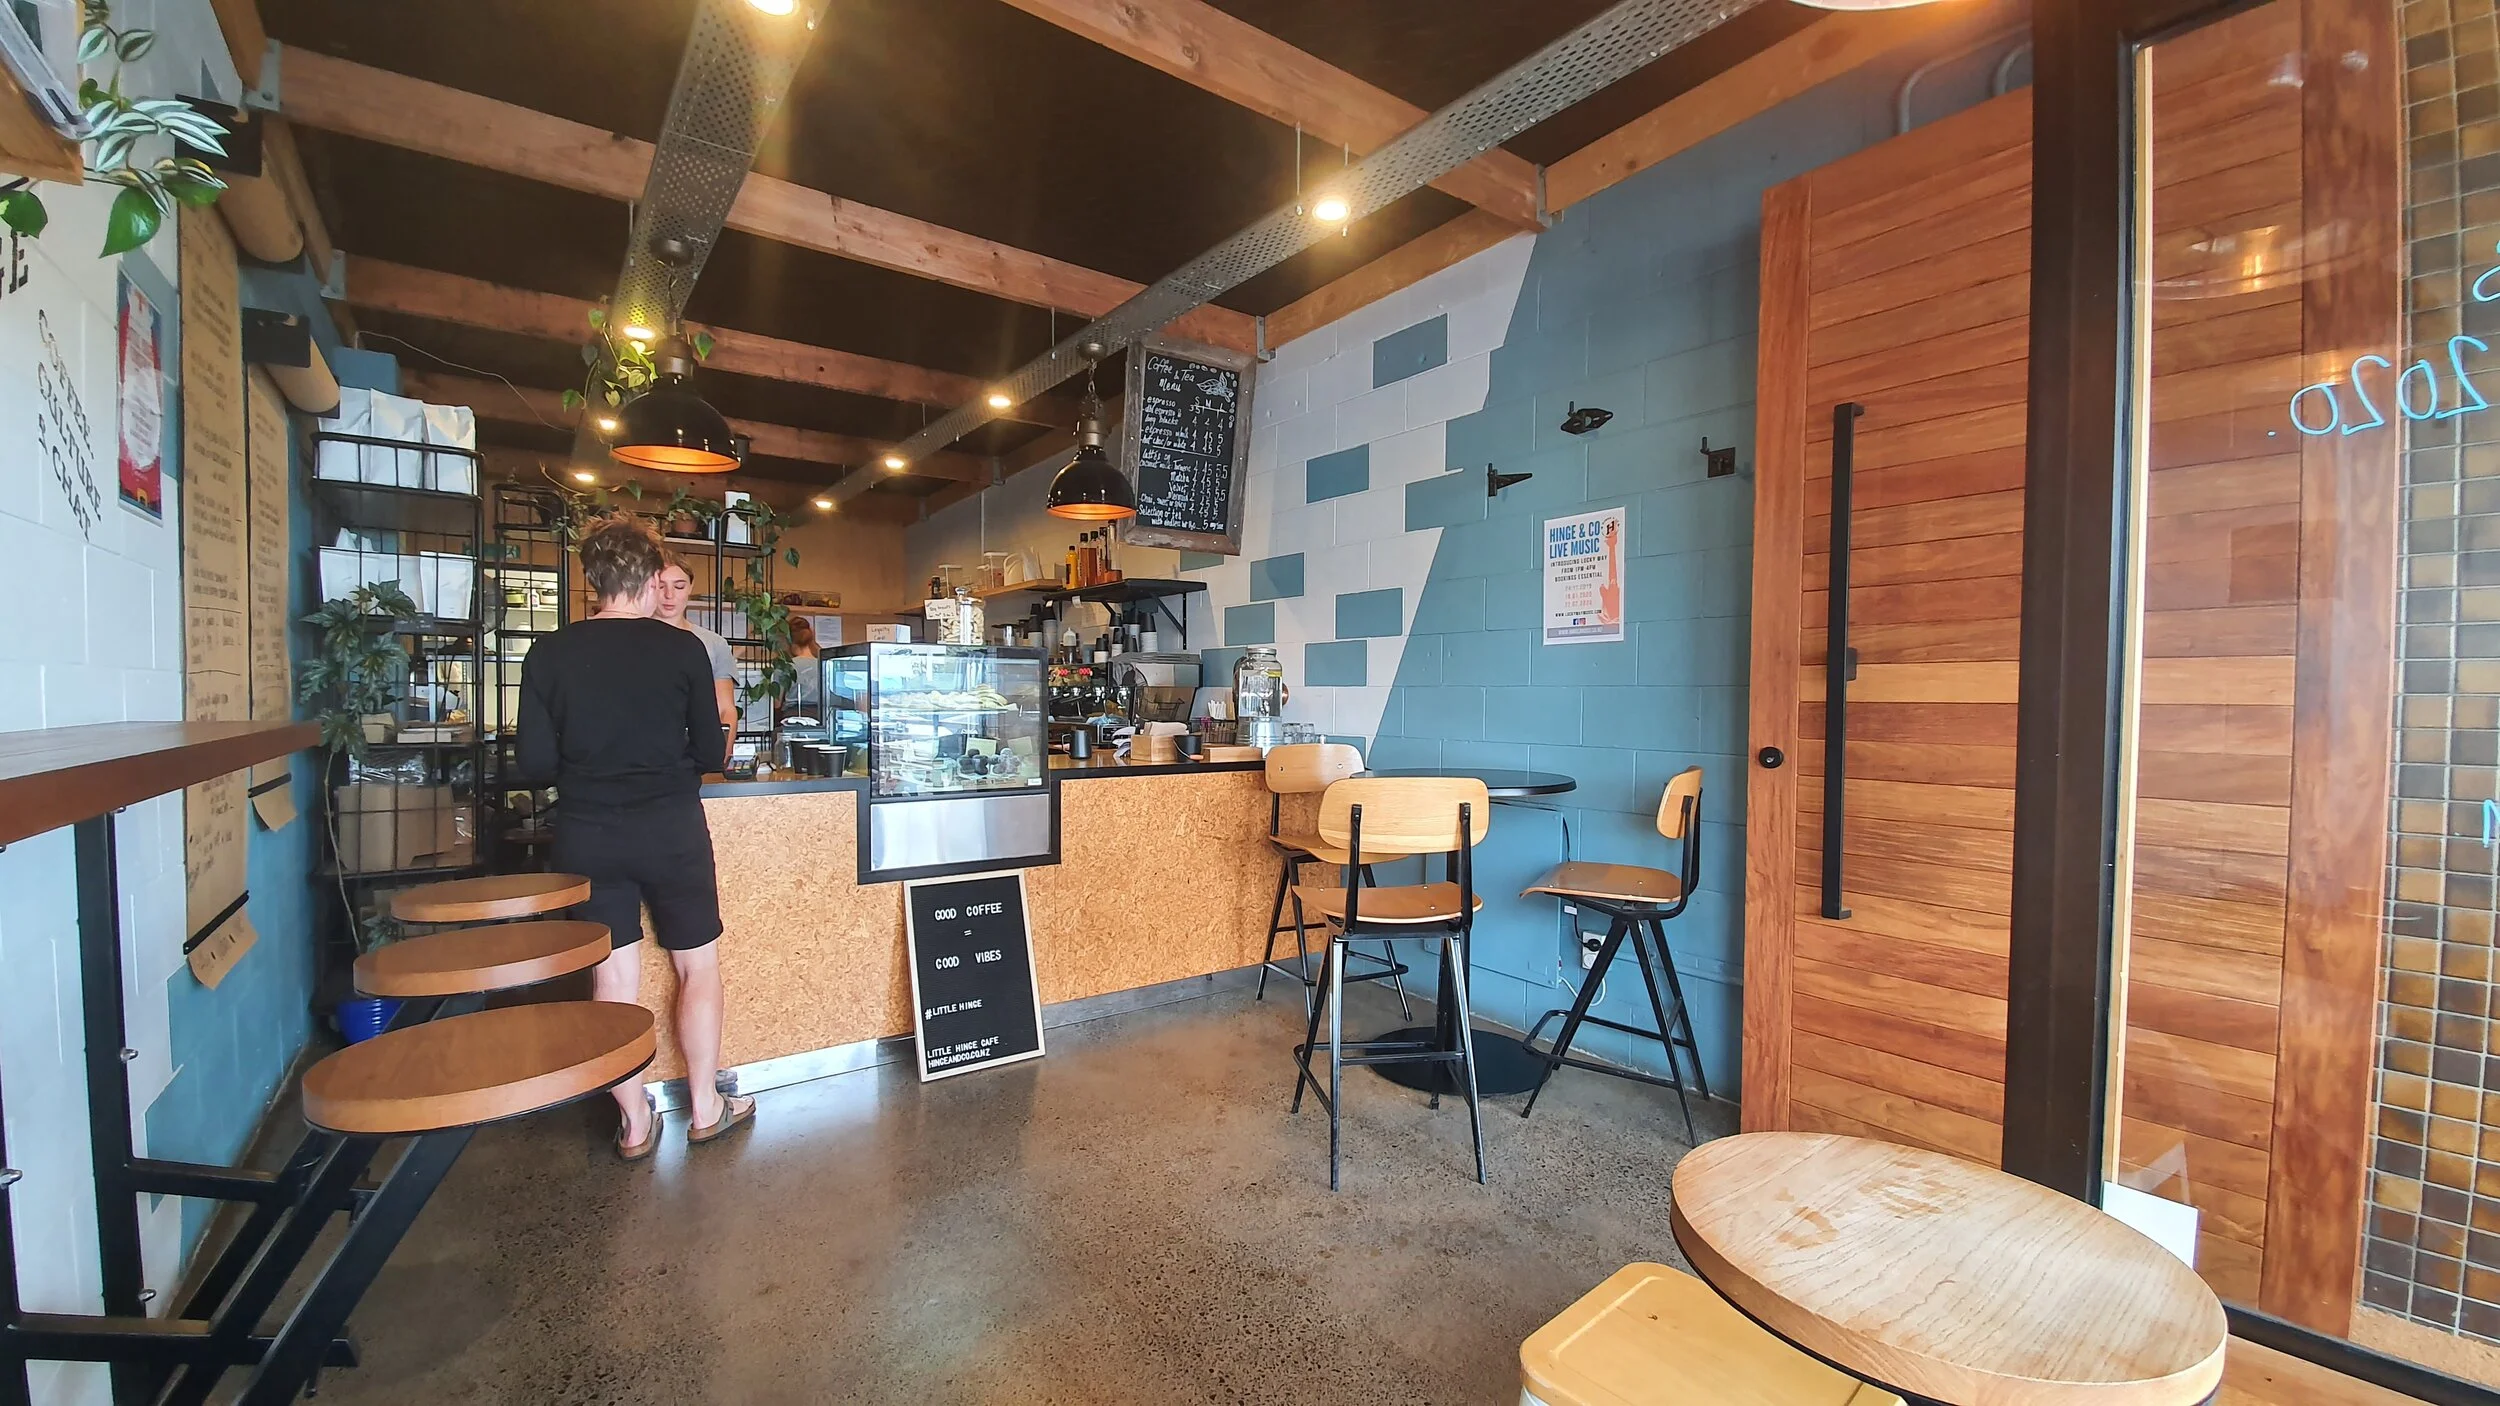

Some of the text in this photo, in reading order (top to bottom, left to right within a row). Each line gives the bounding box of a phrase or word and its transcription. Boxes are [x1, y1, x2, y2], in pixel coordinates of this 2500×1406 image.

[1147, 356, 1173, 374] Coffee
[1180, 369, 1195, 382] Tea
[1159, 378, 1181, 392] Menu
[1146, 396, 1176, 410] espresso
[37, 361, 102, 522] CULTURE
[38, 413, 91, 543] & CHAT
[1139, 504, 1163, 518] Selection
[1549, 524, 1576, 543] HINGE
[1578, 523, 1586, 538] &
[1588, 520, 1600, 537] CO
[1549, 538, 1600, 559] LIVE MUSIC
[1550, 559, 1580, 567] INTRODUCING
[1580, 556, 1595, 564] LUCKY
[1554, 572, 1603, 582] BOOKINGS ESSENTIAL
[934, 902, 1003, 921] GOOD COFFEE
[935, 949, 1002, 970] GOOD VIBES
[924, 1003, 958, 1020] #LITTLE
[926, 1045, 952, 1059] LITTLE
[980, 1036, 1000, 1047] CAFE
